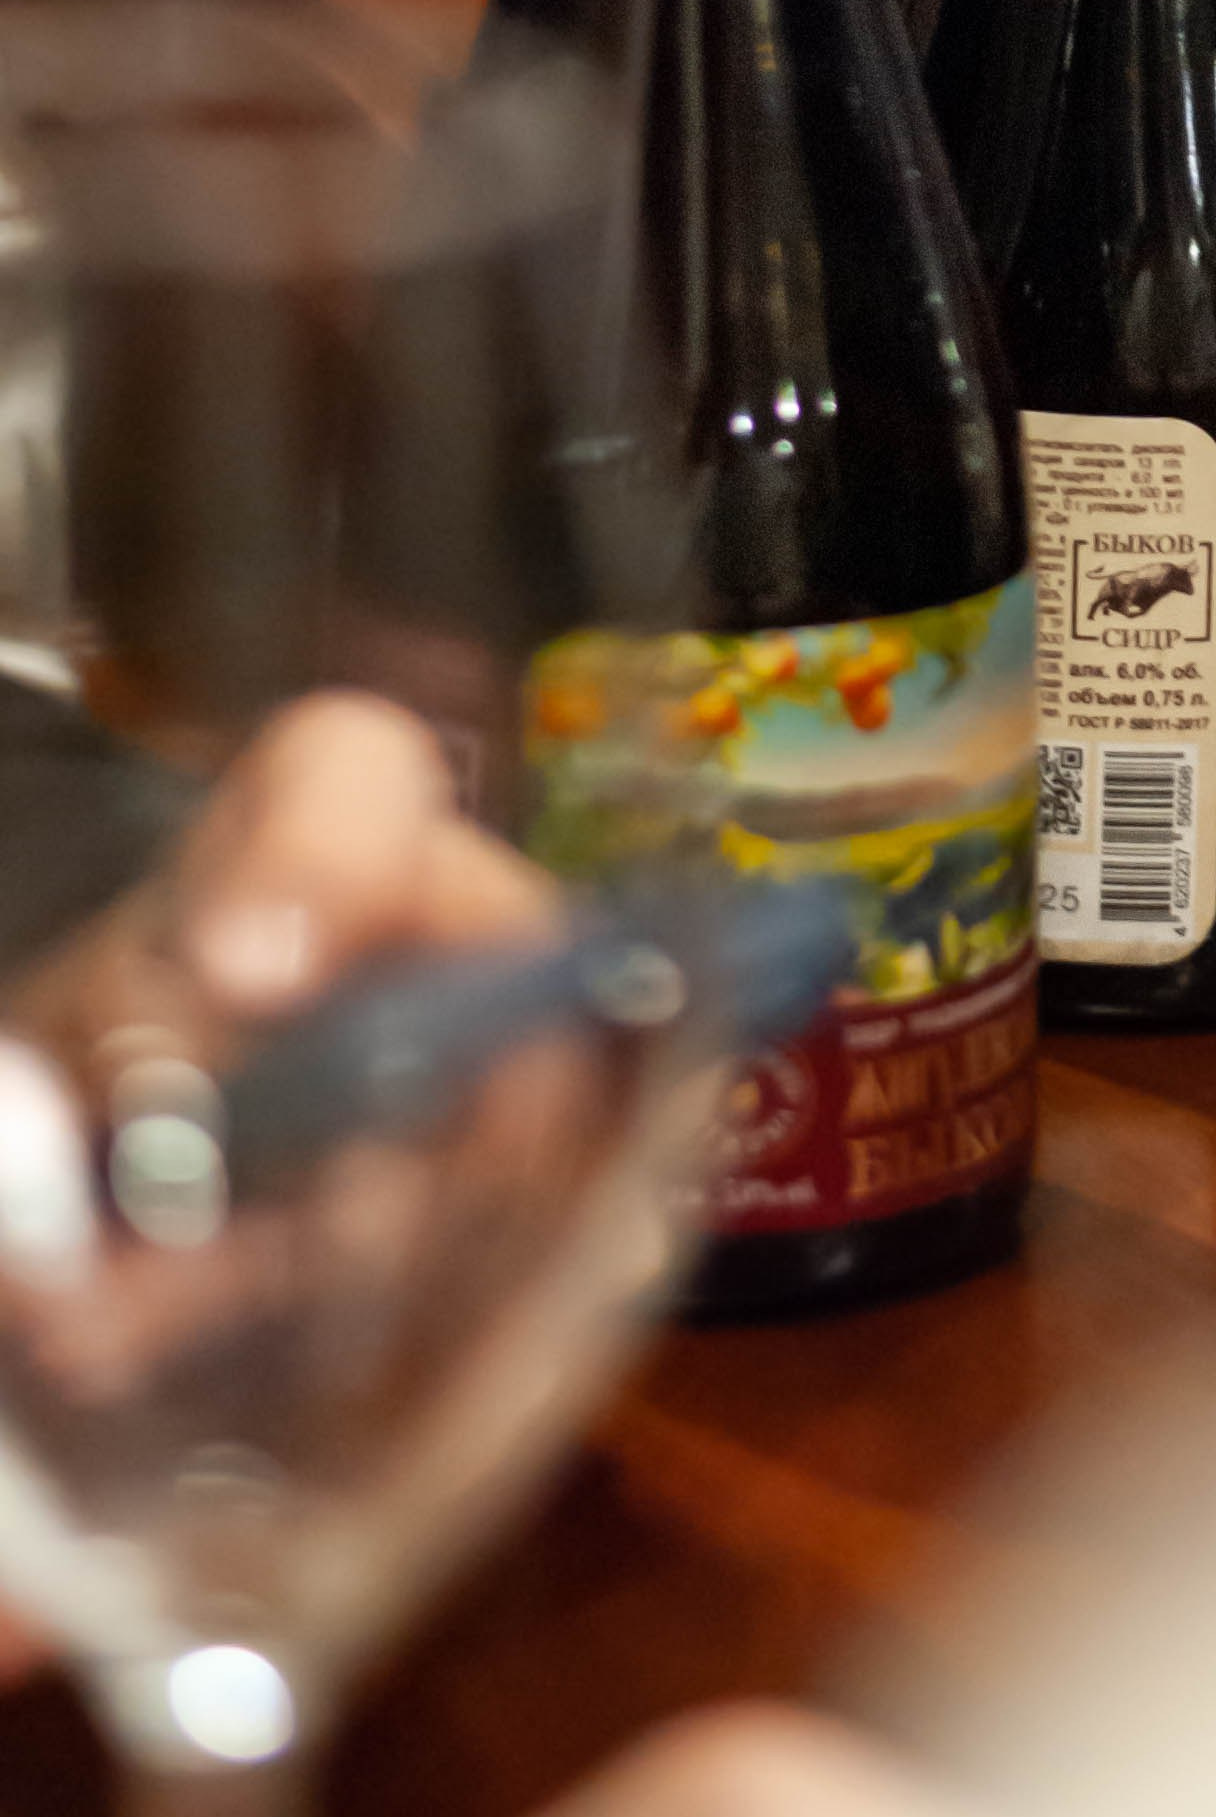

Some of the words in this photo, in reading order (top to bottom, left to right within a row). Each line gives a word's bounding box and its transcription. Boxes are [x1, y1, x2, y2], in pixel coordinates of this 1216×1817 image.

[1093, 533, 1195, 555] БЫКОВ
[1102, 627, 1183, 650] СИДР
[1067, 687, 1137, 706] объем
[1142, 689, 1185, 708] 0,75
